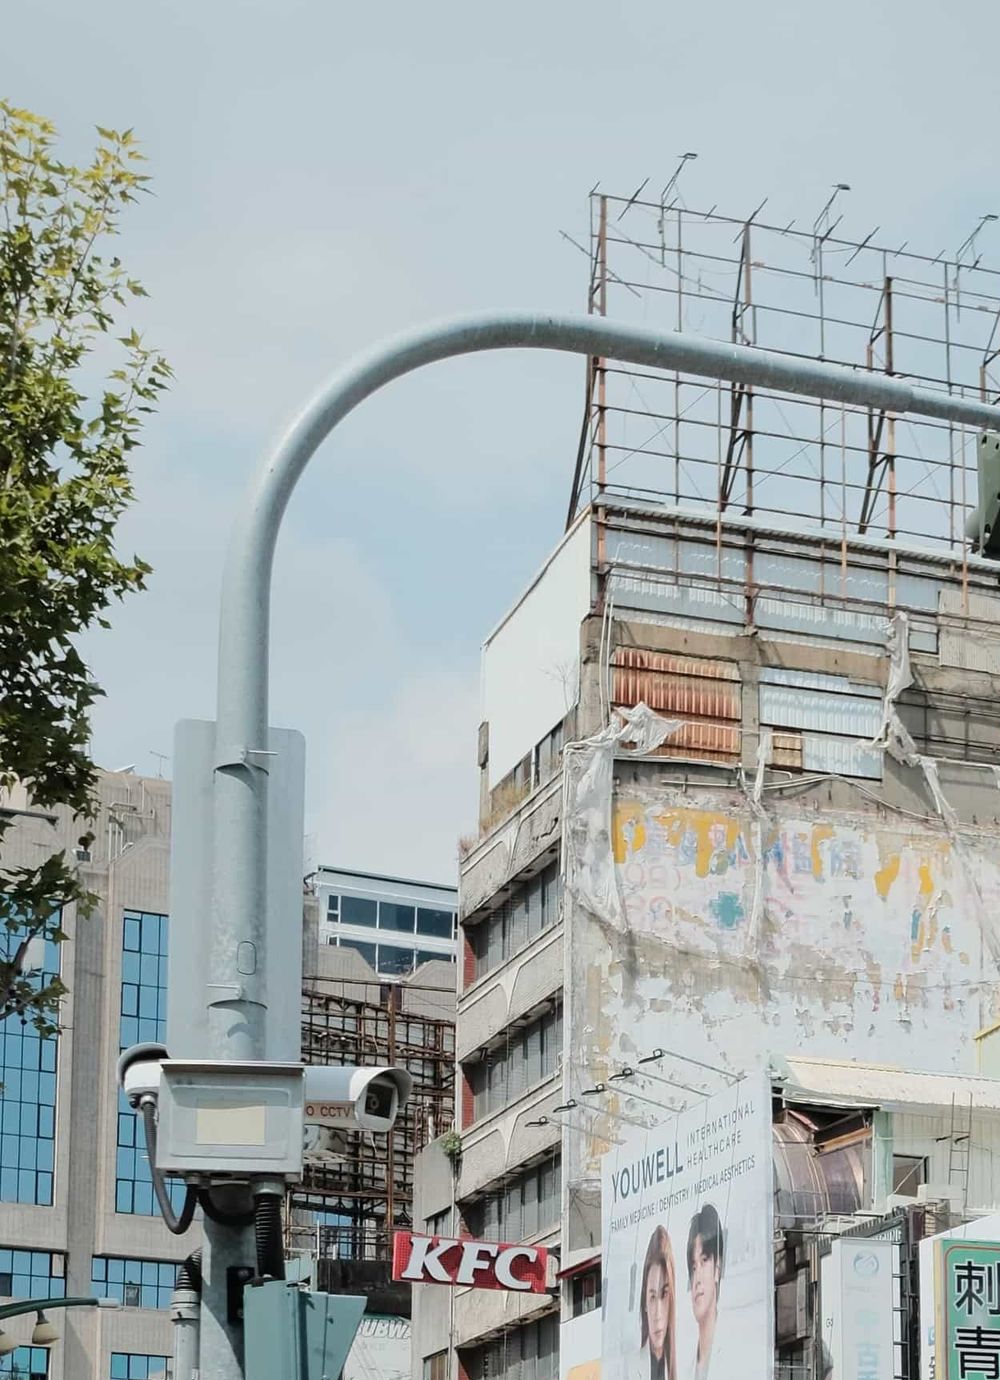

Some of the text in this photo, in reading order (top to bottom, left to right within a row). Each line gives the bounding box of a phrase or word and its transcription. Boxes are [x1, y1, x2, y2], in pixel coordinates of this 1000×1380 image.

[320, 1106, 352, 1117] CCTV
[687, 1101, 755, 1147] INTERNATIONAL
[687, 1130, 742, 1168] HEALTHCARE
[612, 1142, 684, 1203] YOUWELL
[401, 1236, 538, 1290] KFC
